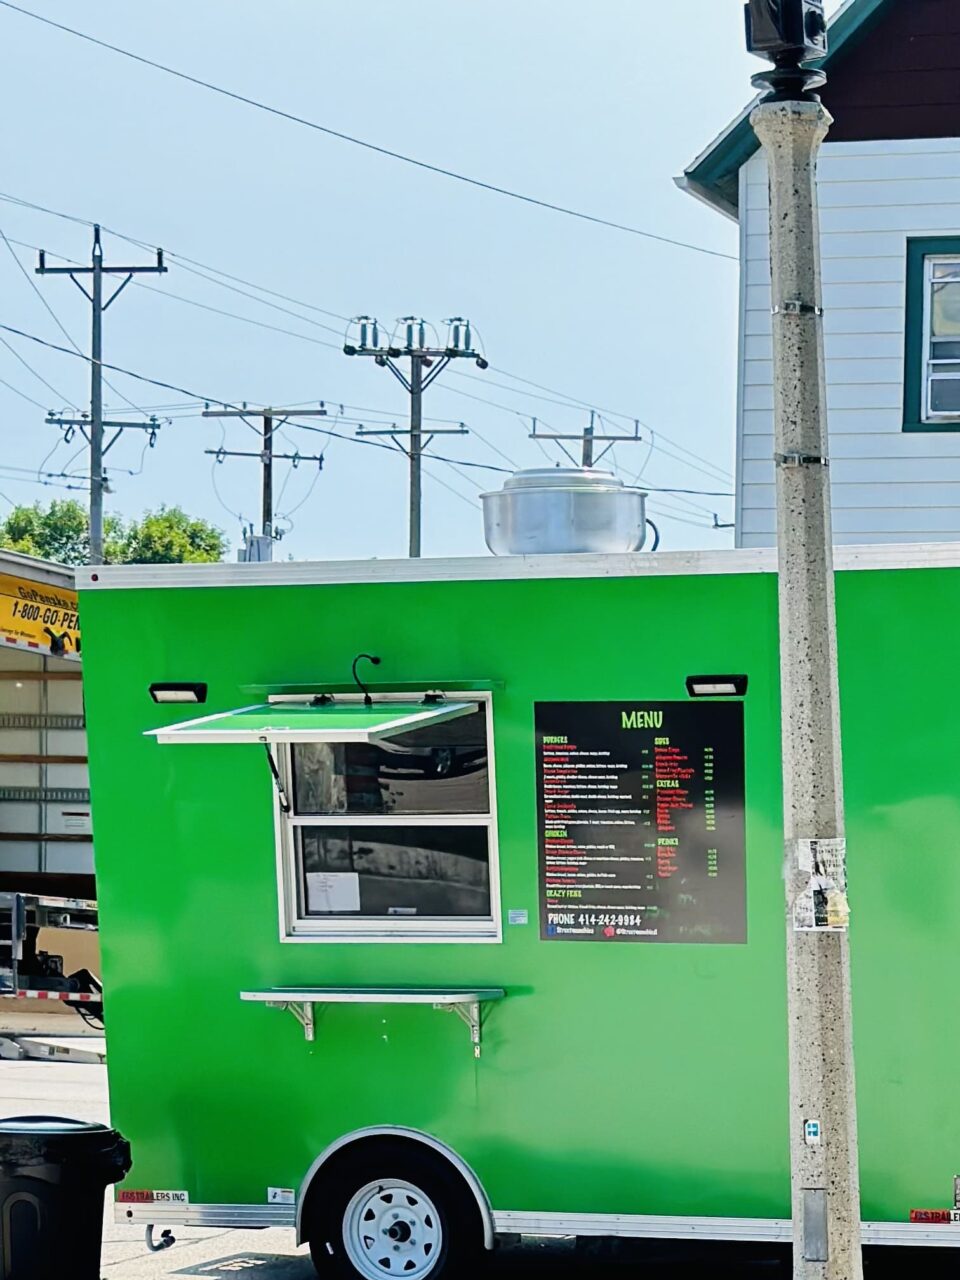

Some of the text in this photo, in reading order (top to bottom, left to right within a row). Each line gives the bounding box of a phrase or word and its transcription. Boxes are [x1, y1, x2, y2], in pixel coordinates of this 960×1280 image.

[621, 711, 663, 729] MENU
[656, 780, 679, 788] EXTRAS
[548, 913, 641, 926] PHONE 414-242-9984
[172, 1192, 185, 1202] INC
